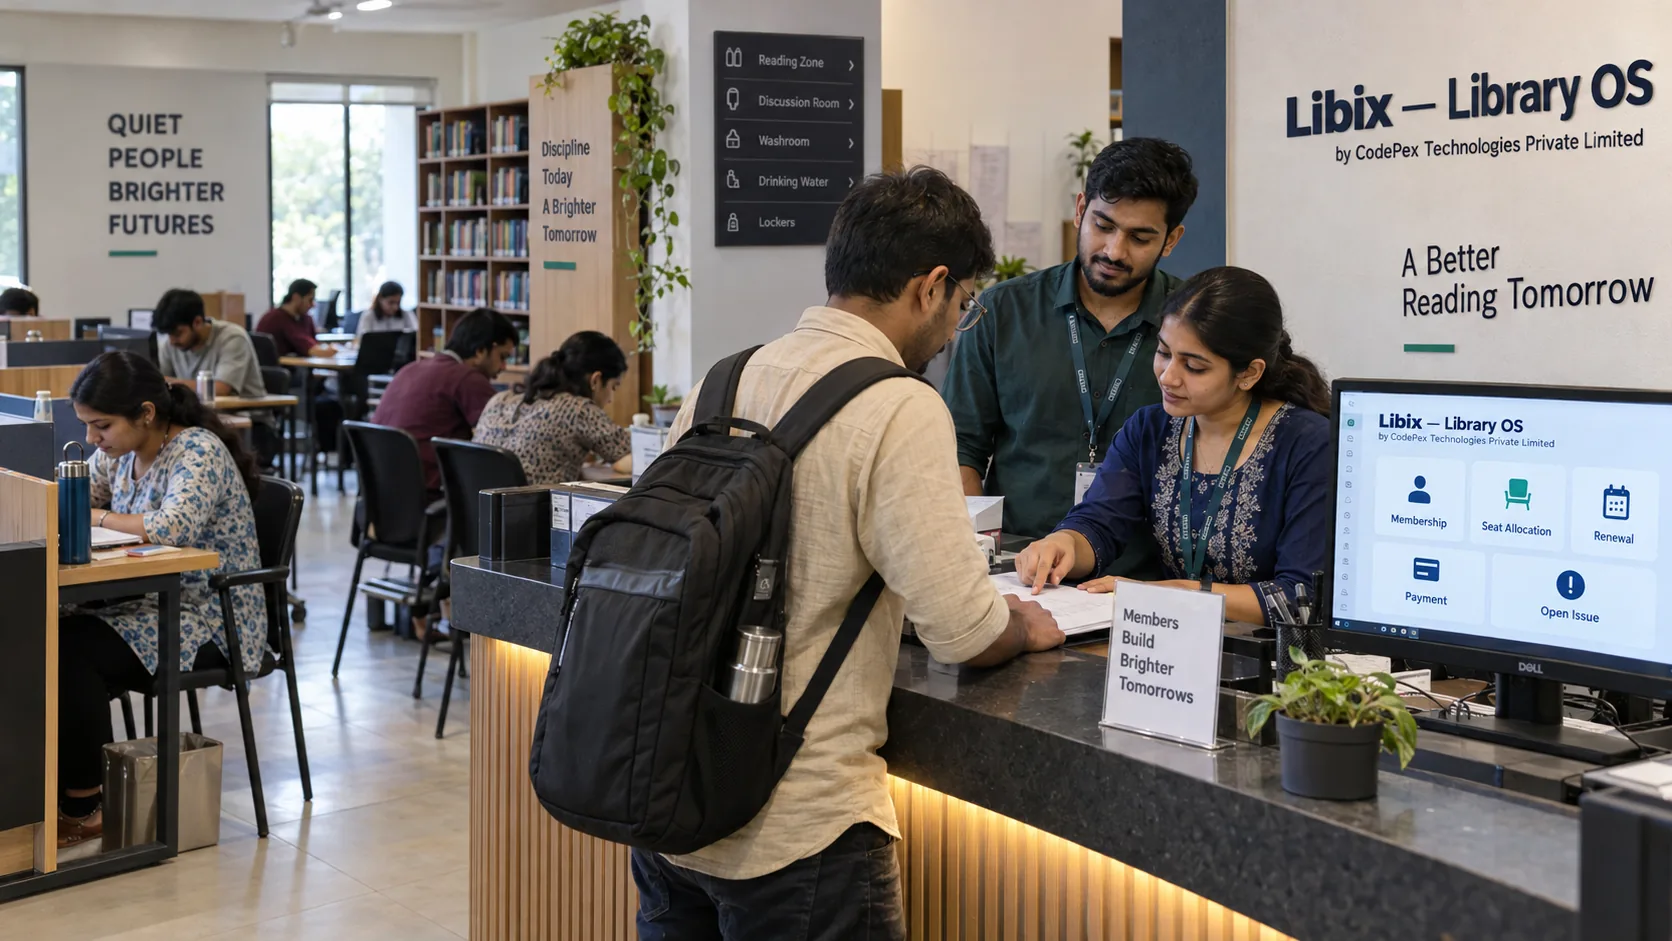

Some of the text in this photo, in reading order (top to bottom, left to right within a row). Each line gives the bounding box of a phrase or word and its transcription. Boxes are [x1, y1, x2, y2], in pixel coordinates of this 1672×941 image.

[758, 53, 825, 70] Reading Zone
[758, 94, 840, 109] Discussion Room
[1286, 84, 1394, 139] Libix
[1448, 71, 1582, 122] Library
[1590, 59, 1654, 110] OS
[107, 113, 183, 138] QUIET
[541, 139, 590, 160] Discipline
[758, 134, 810, 147] Washroom
[1335, 127, 1644, 166] by CodePex Technologies Private Limited
[108, 147, 203, 169] PEOPLE
[542, 168, 573, 188] Today
[758, 175, 829, 190] Drinking Water
[108, 181, 225, 202] BRIGHTER
[542, 197, 596, 218] A Brighter
[108, 213, 215, 236] FUTURES
[758, 216, 796, 228] Lockers
[542, 225, 597, 243] Tomorrow
[1401, 244, 1500, 278] A Better
[1403, 276, 1655, 320] Reading Tomorrow
[1378, 412, 1423, 430] Libix
[1445, 416, 1497, 435] Library
[1500, 418, 1524, 434] OS
[1378, 431, 1555, 448] by CodePex Technologies Private Limited
[1390, 513, 1448, 530] Membership
[1481, 520, 1552, 537] Seat Allocation
[1594, 530, 1635, 545] Renewal
[1405, 591, 1448, 606] Payment
[1123, 608, 1179, 630] Members
[1540, 605, 1600, 623] Open Issue
[1122, 630, 1155, 649] Build
[1120, 653, 1174, 676] Brighter
[1518, 661, 1544, 675] DELL
[1119, 675, 1194, 704] Tomorrows
